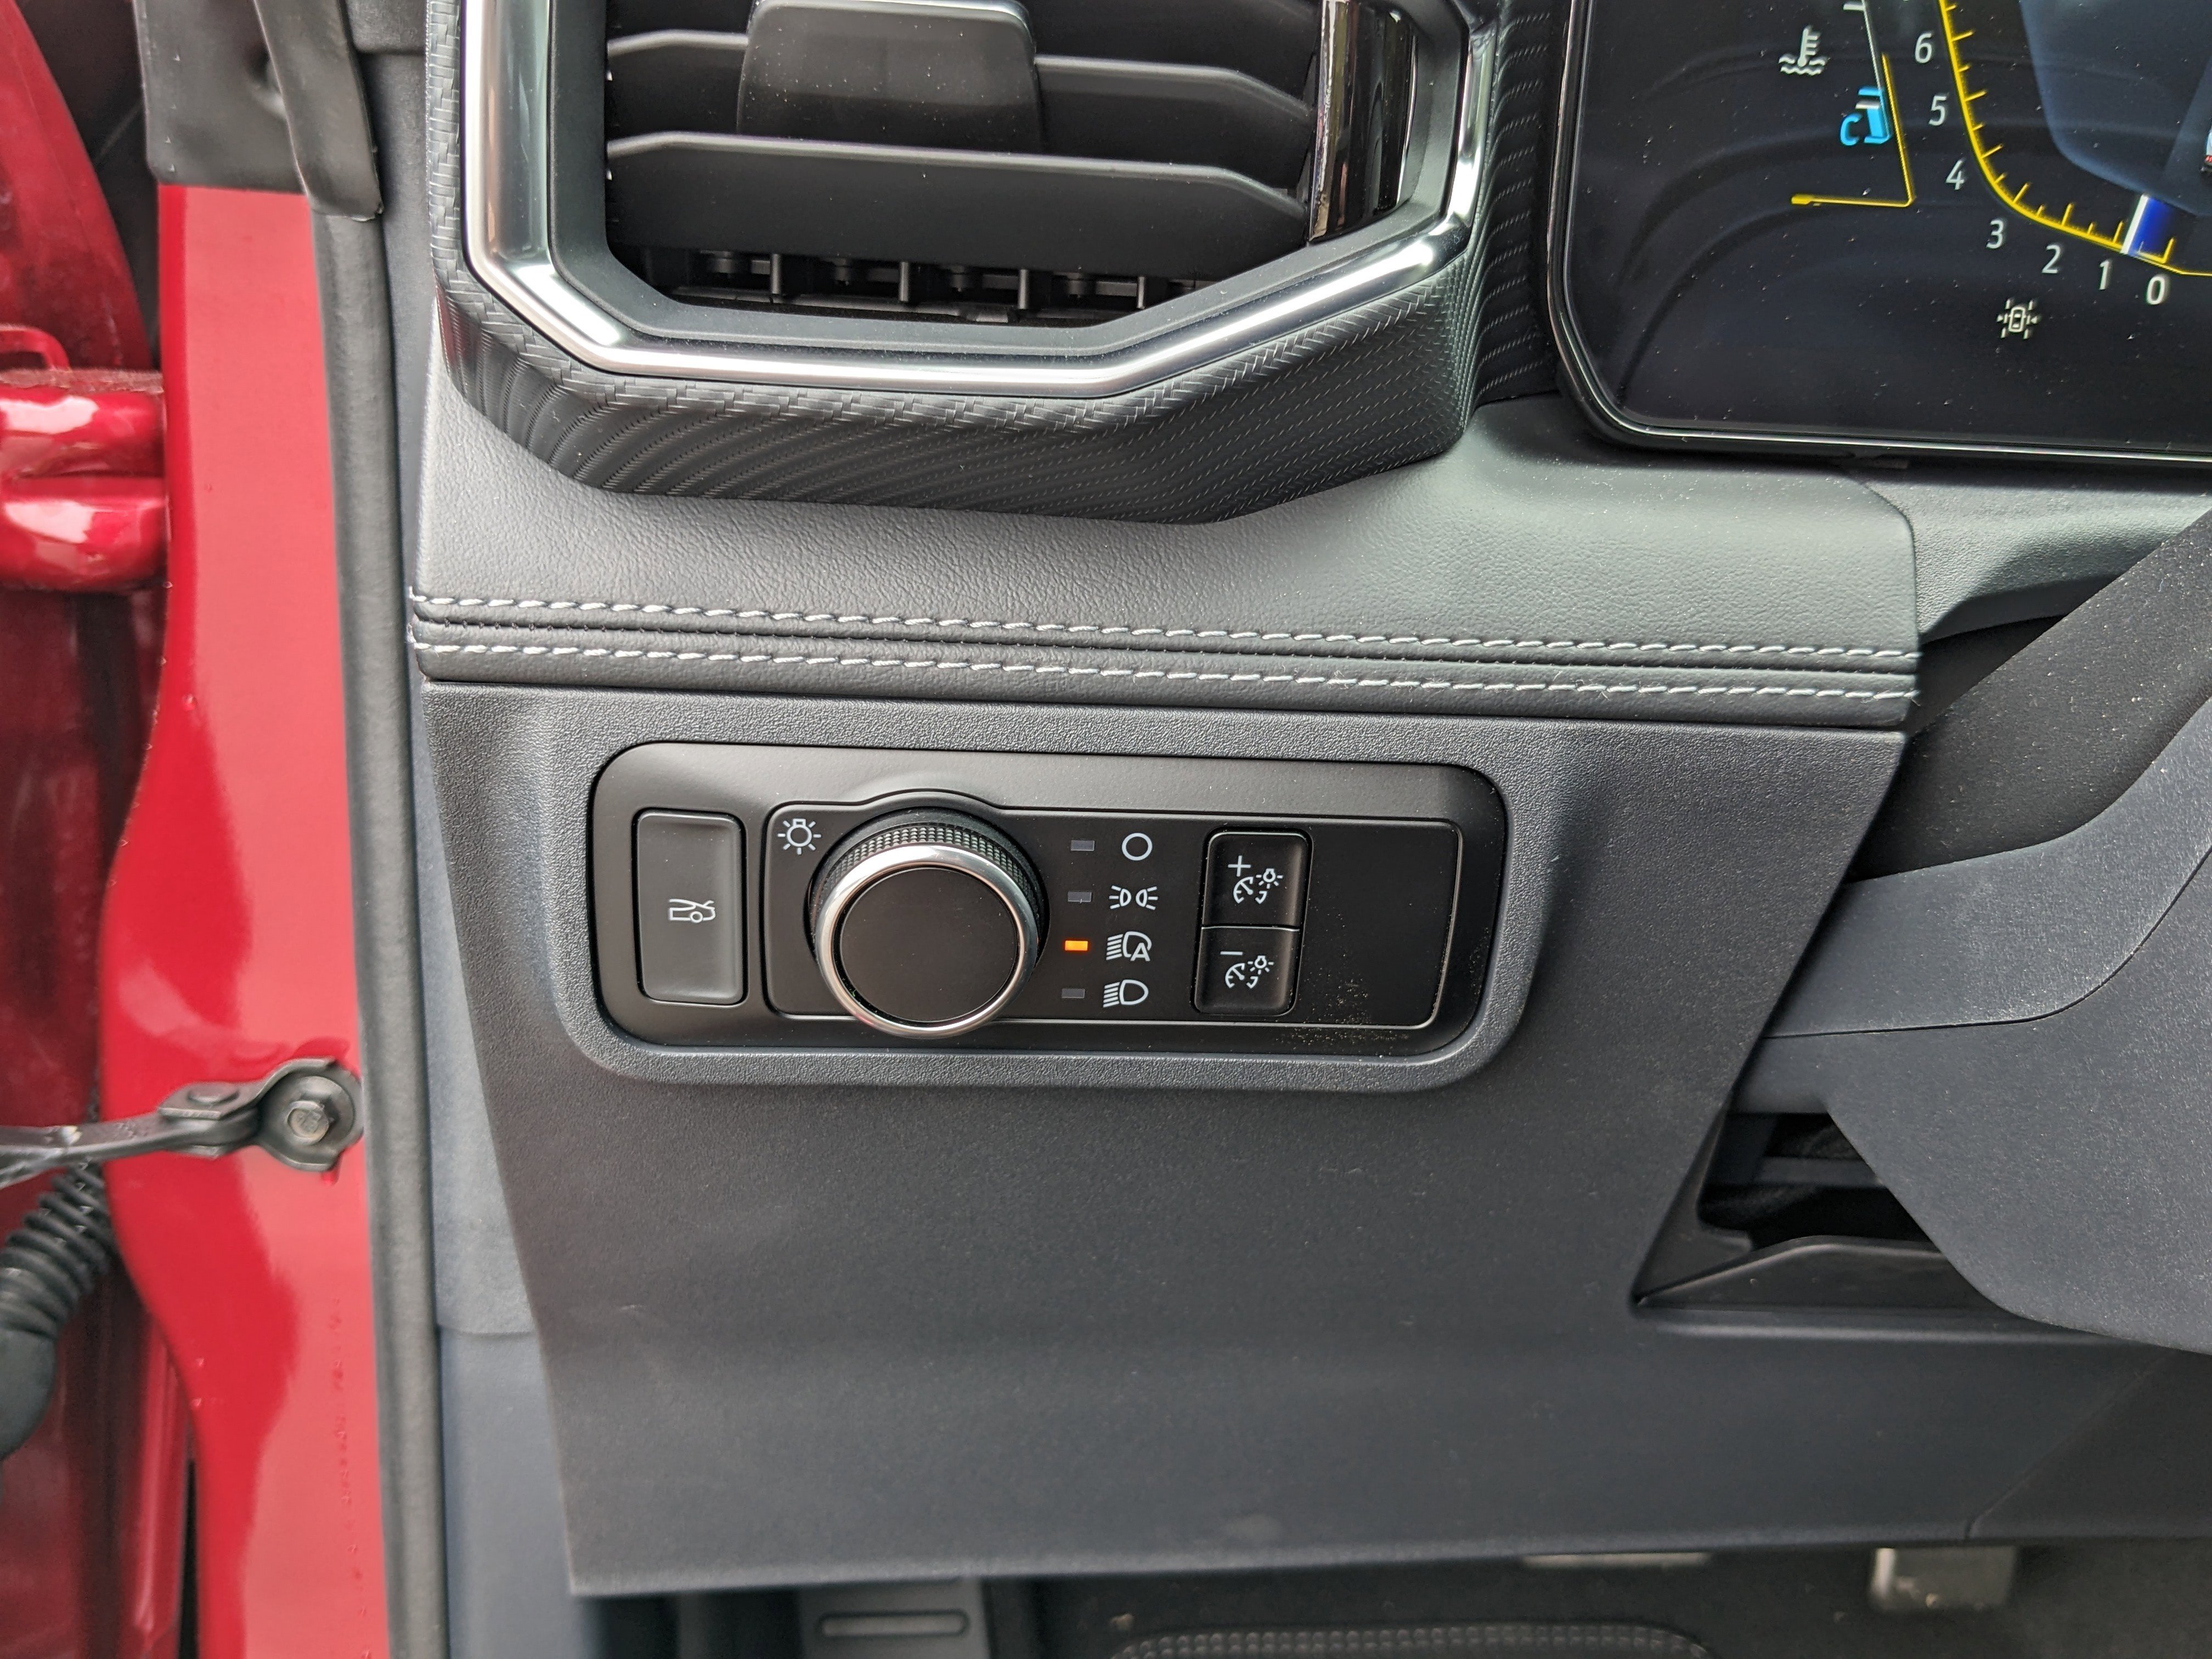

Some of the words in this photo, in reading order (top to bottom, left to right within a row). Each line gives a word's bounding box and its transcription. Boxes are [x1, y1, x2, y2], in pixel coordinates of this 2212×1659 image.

[1915, 32, 1933, 64] 6
[1928, 95, 1948, 126] 5
[1840, 113, 1860, 146] C
[1946, 160, 1965, 190] 4
[1987, 219, 2005, 249] 3
[2042, 244, 2062, 274] 2
[2099, 260, 2111, 290] 1
[2146, 275, 2166, 305] 0
